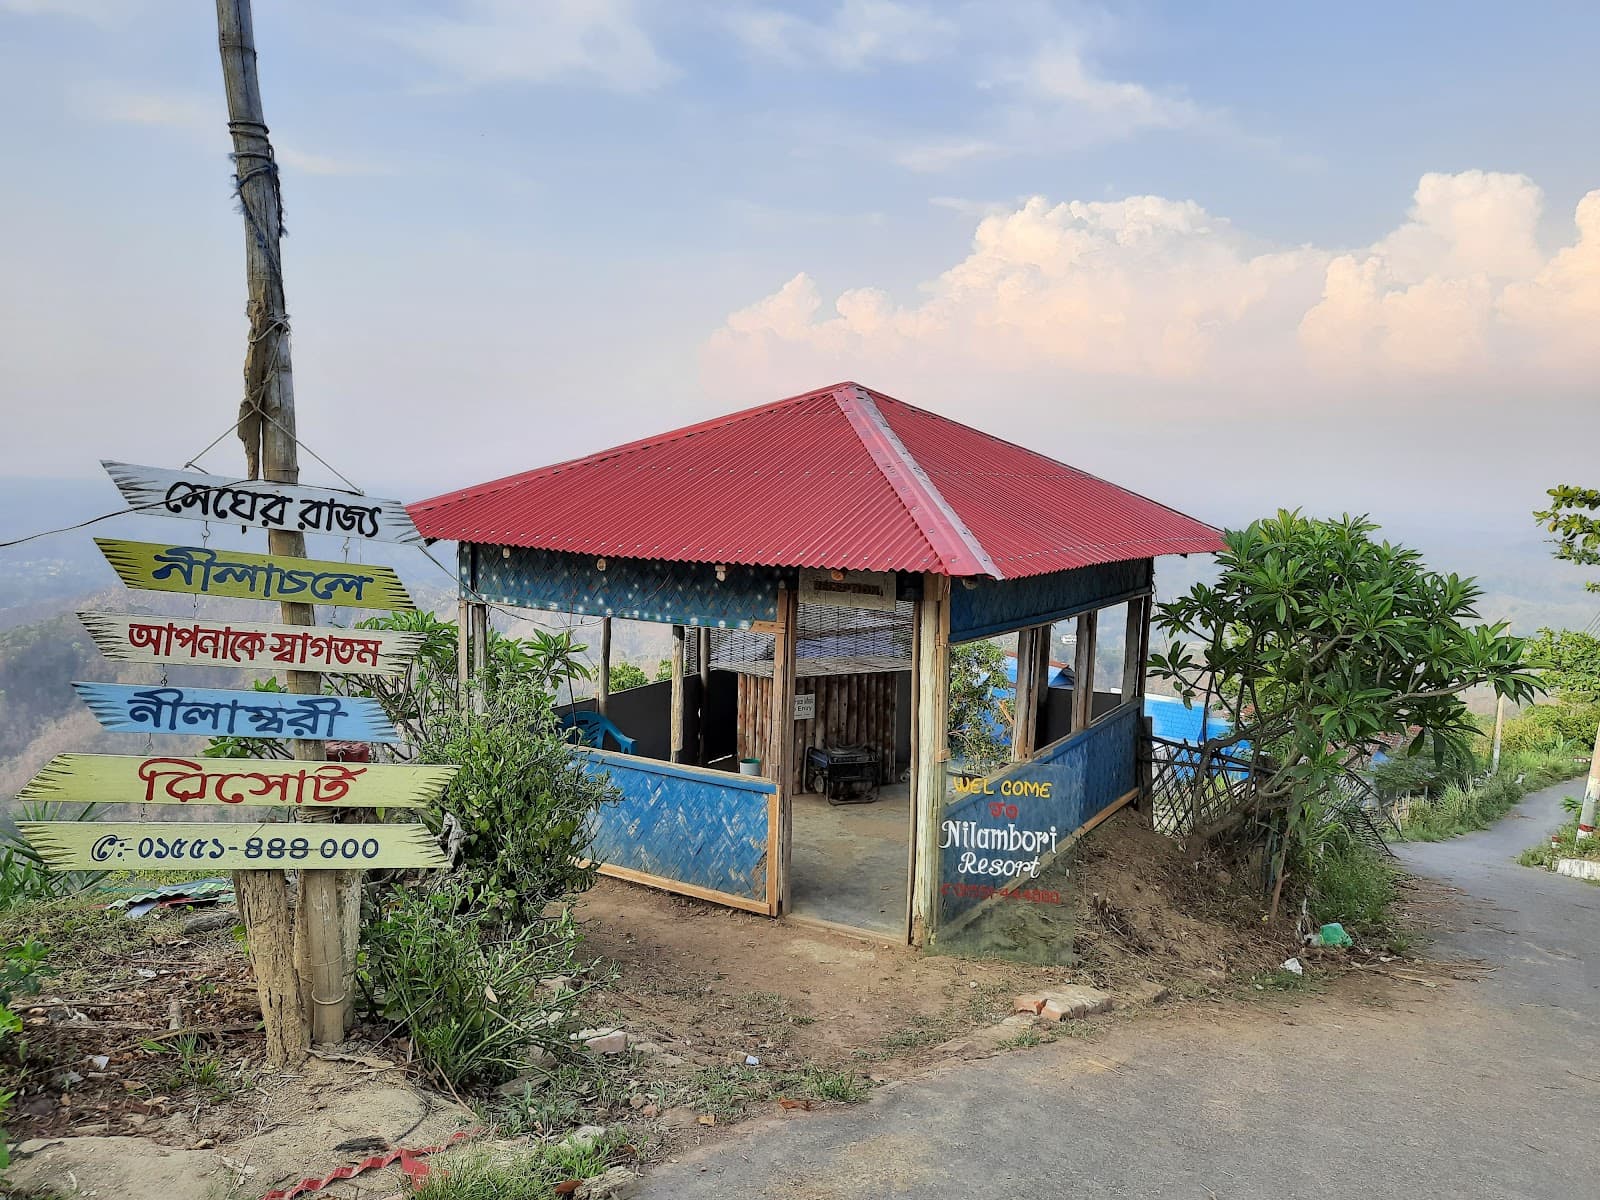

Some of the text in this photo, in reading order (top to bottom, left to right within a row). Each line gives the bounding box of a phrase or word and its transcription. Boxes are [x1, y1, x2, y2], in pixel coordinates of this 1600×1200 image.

[165, 481, 382, 538] মেঘের রাজ্য
[152, 546, 375, 600] নীলাচলে
[128, 622, 382, 667] আপনাকে স্বাগতম
[138, 757, 368, 803] রিসোর্ট
[938, 820, 1058, 854] Nilambori
[957, 851, 1041, 879] Resort
